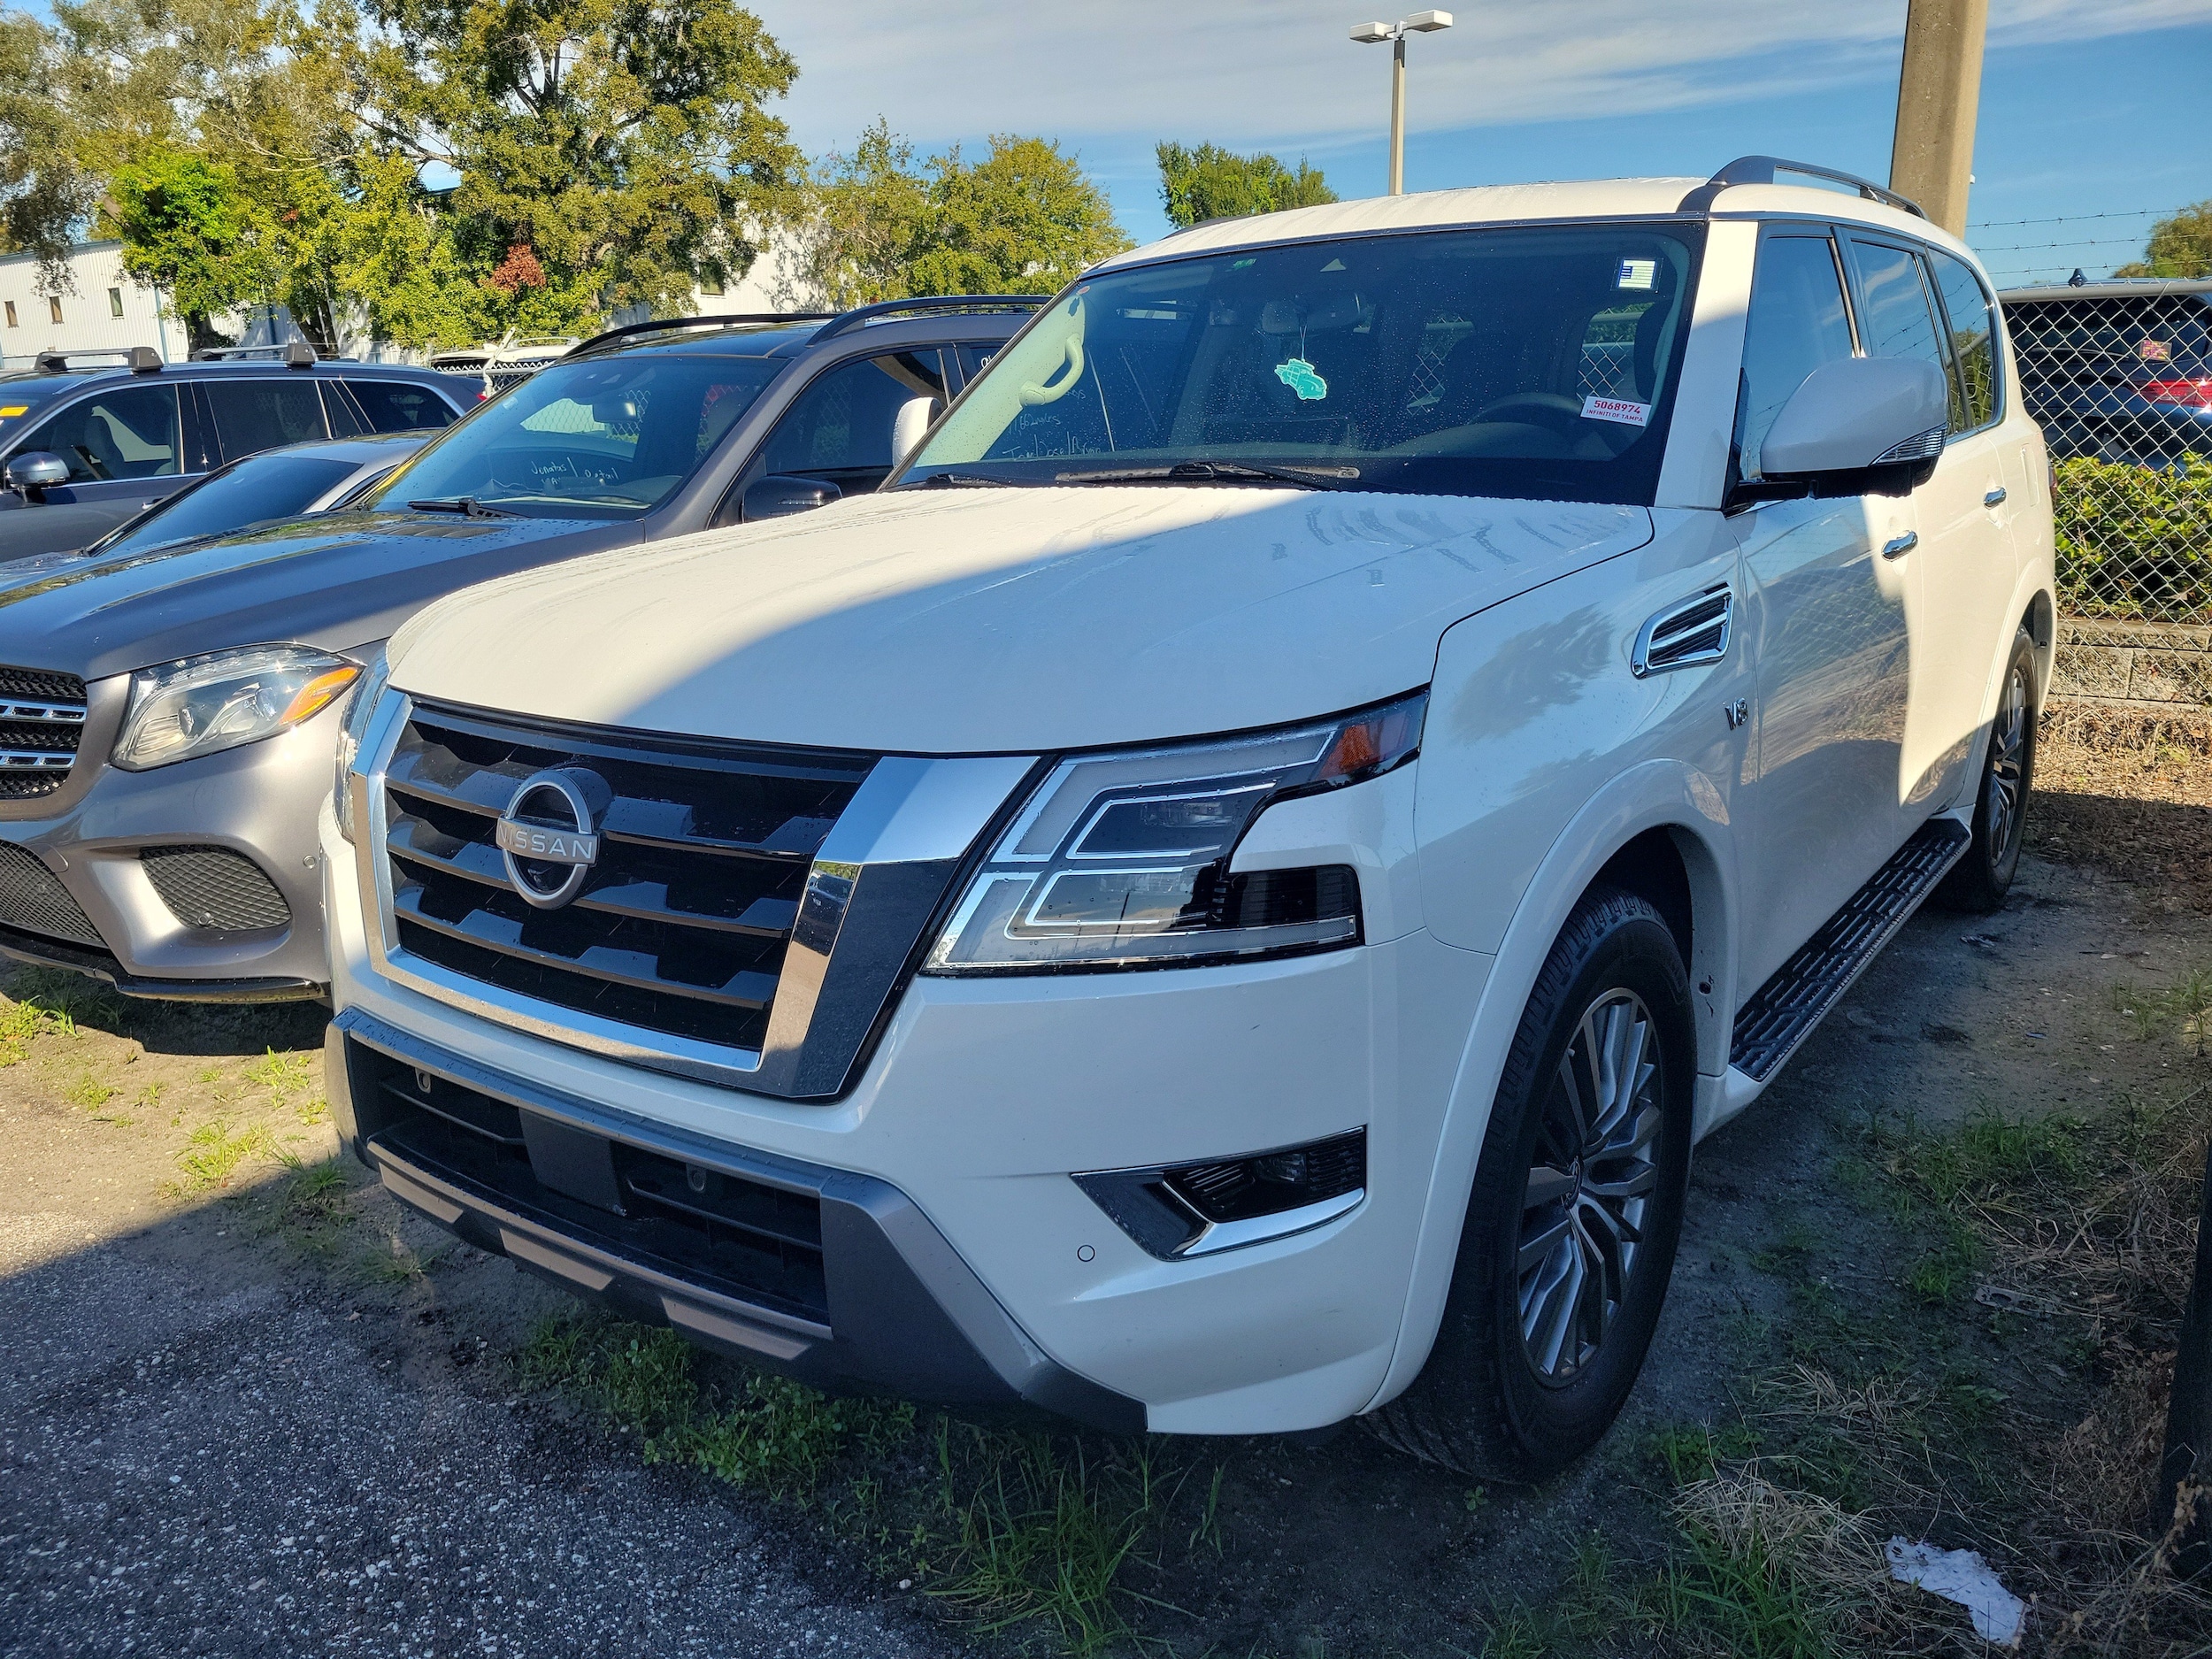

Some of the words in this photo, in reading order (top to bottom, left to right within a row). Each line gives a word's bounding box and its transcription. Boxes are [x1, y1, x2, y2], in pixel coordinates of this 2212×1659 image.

[1594, 400, 1640, 414] 5068974
[1622, 413, 1643, 422] TAMPA
[1724, 698, 1748, 731] V8
[497, 823, 592, 859] NISSAN
